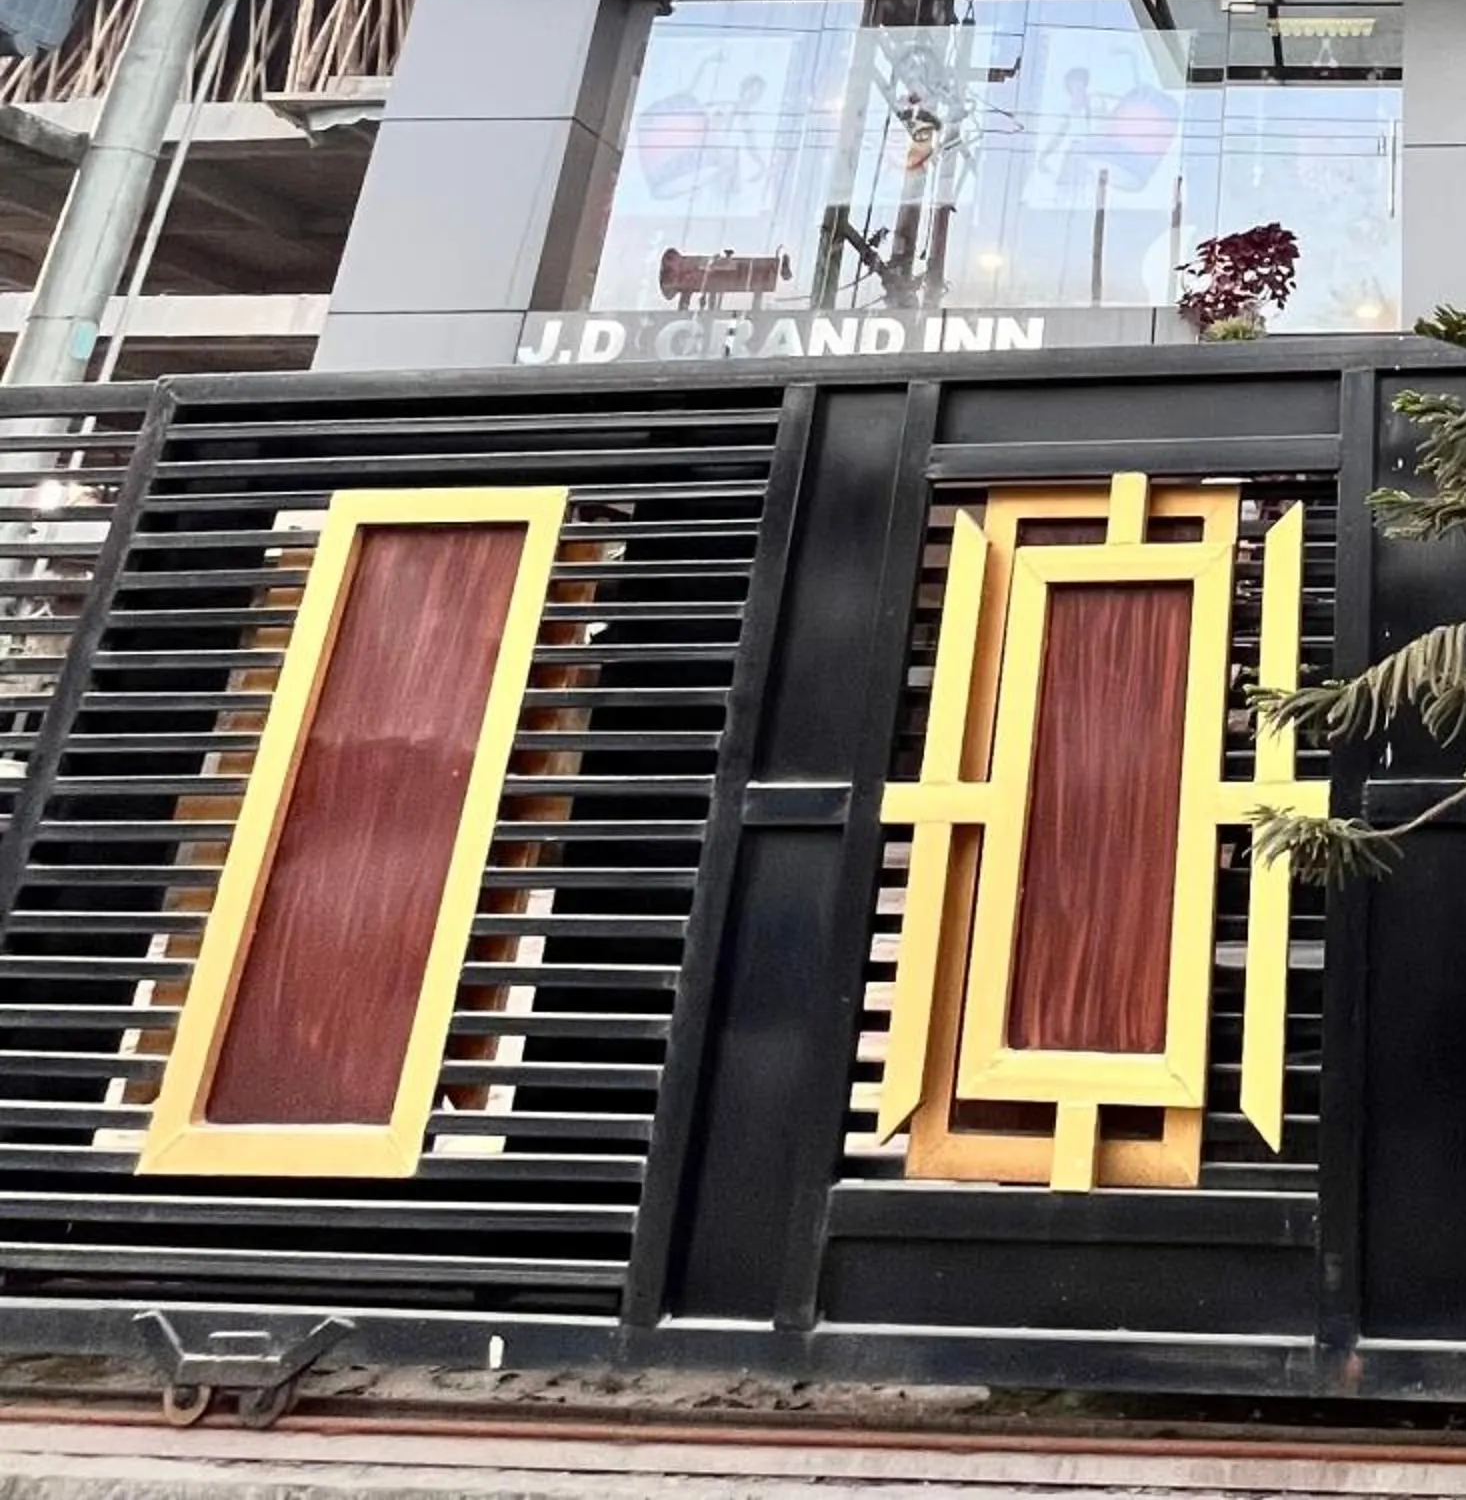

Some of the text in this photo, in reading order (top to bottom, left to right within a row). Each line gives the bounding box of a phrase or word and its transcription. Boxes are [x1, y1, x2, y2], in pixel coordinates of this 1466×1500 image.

[517, 316, 1046, 365] J.D GRAND INN
